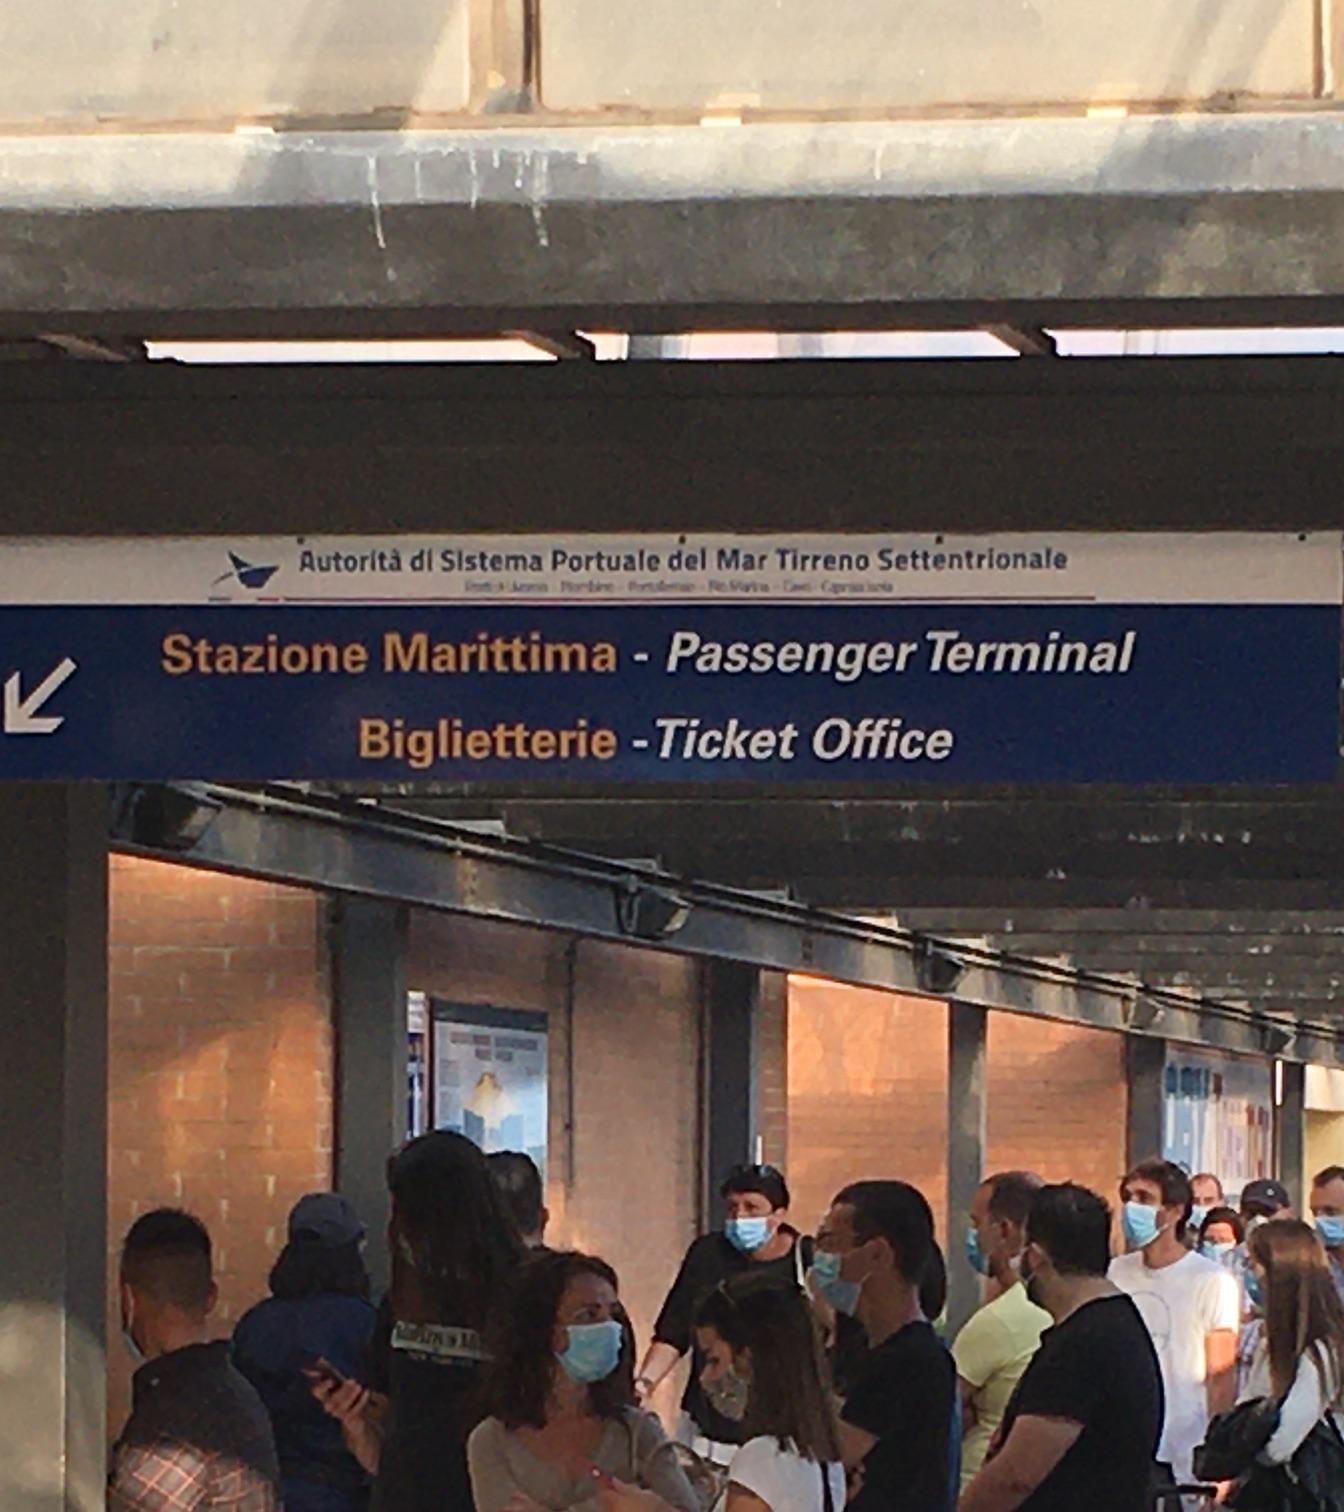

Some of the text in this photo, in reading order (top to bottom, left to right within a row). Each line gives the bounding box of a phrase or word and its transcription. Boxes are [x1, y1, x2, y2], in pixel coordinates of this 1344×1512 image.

[299, 548, 1068, 573] Autorità di Sistema Portuale del Mar Tirreno Settentrionale
[161, 633, 368, 674] Stazione
[383, 632, 617, 673] Marittima
[666, 631, 918, 682] Passenger
[926, 631, 1136, 673] Terminal
[359, 718, 617, 769] Biglietterie
[813, 718, 954, 760] Office
